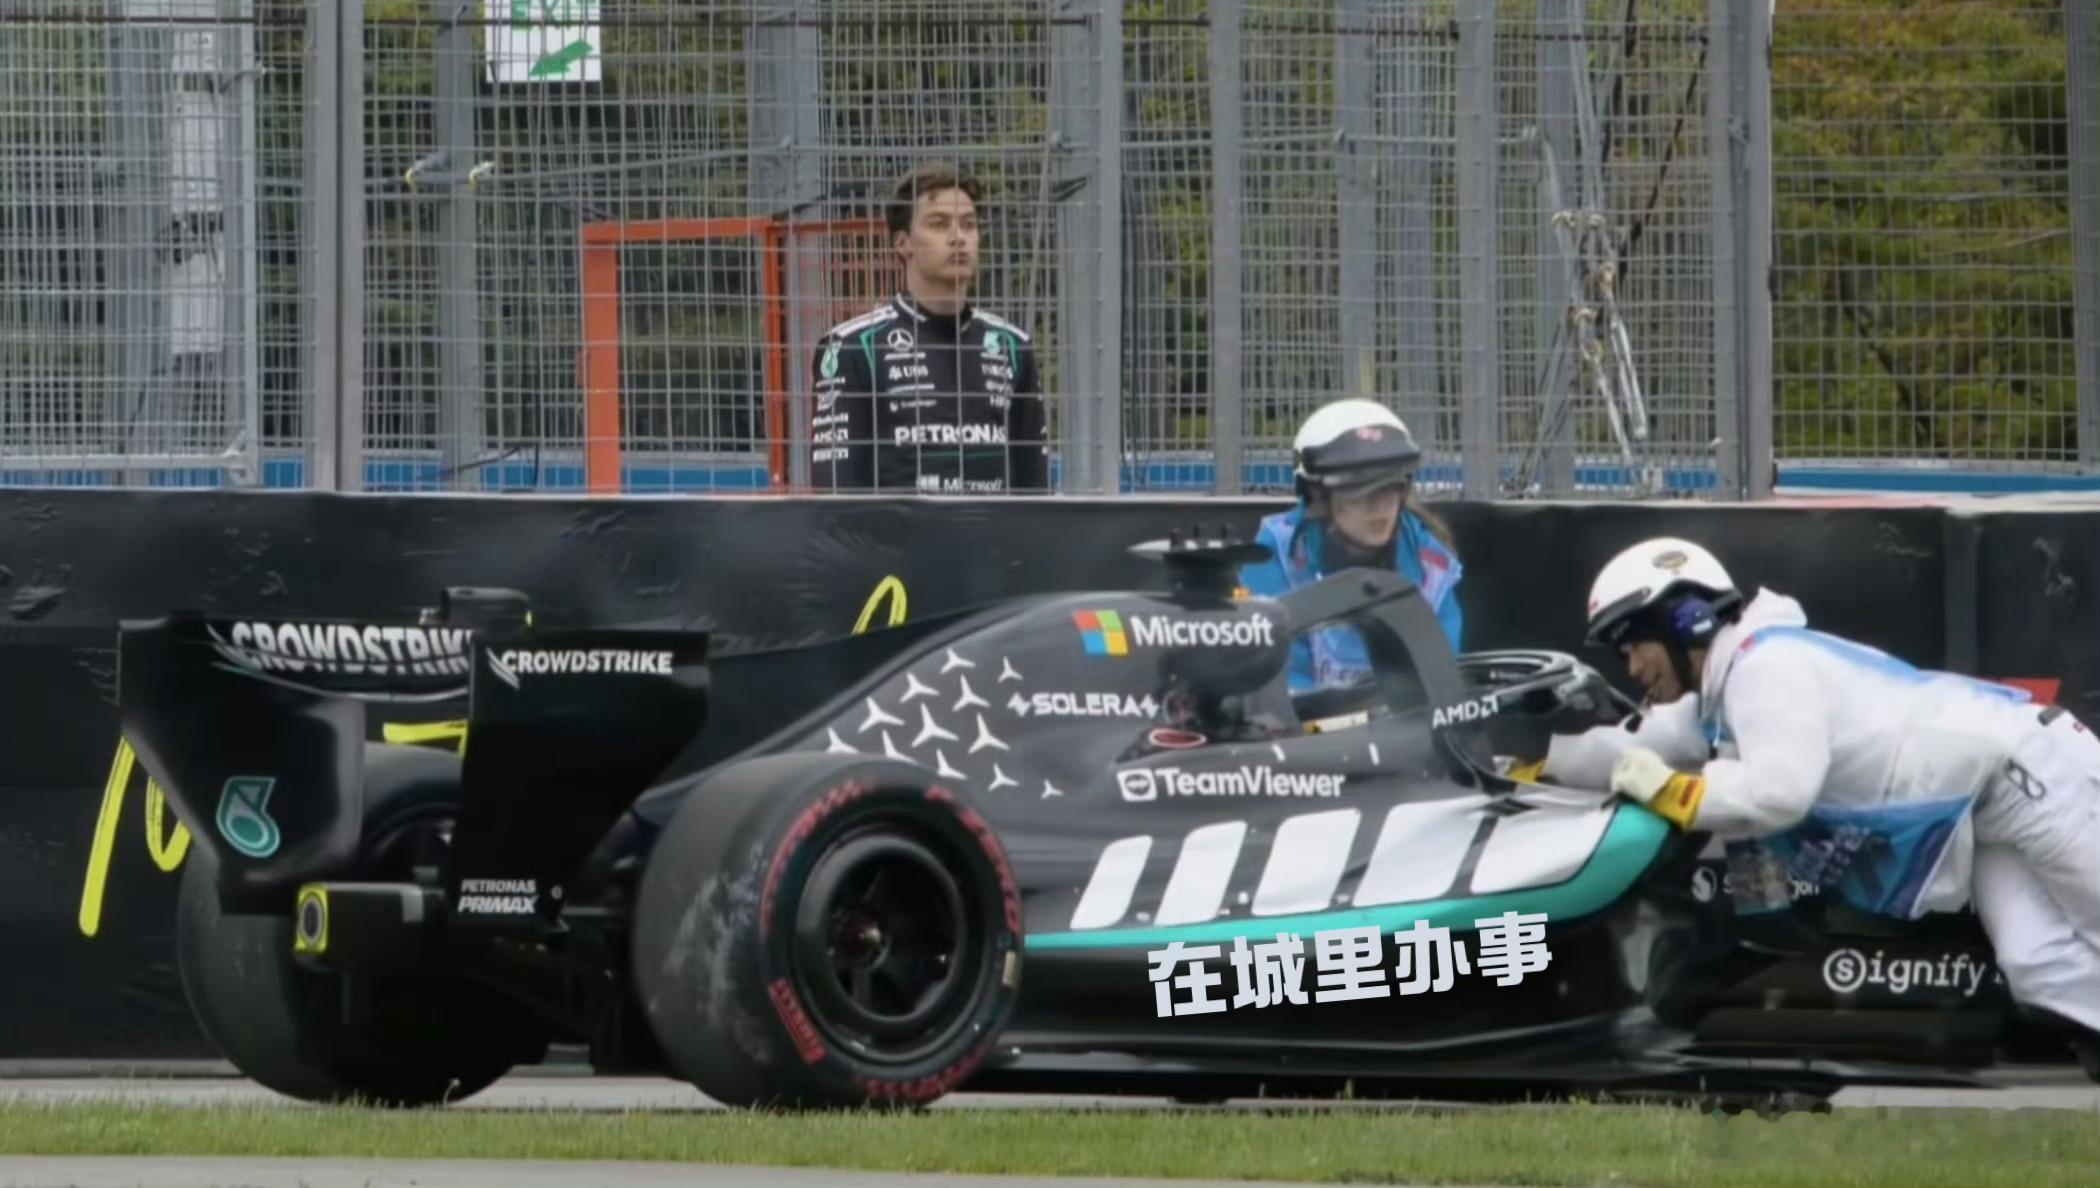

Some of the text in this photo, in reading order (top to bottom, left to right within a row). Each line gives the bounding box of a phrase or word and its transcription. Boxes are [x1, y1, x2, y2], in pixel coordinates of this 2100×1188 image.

[1130, 612, 1274, 648] Microsoft
[231, 621, 473, 675] CROWDSTRIK
[501, 650, 673, 674] CROWDSTRIKE
[1031, 692, 1143, 717] SOLERA
[1156, 765, 1346, 797] TeamViewer
[462, 879, 537, 893] PETRONAS
[458, 895, 540, 914] PRIMAX
